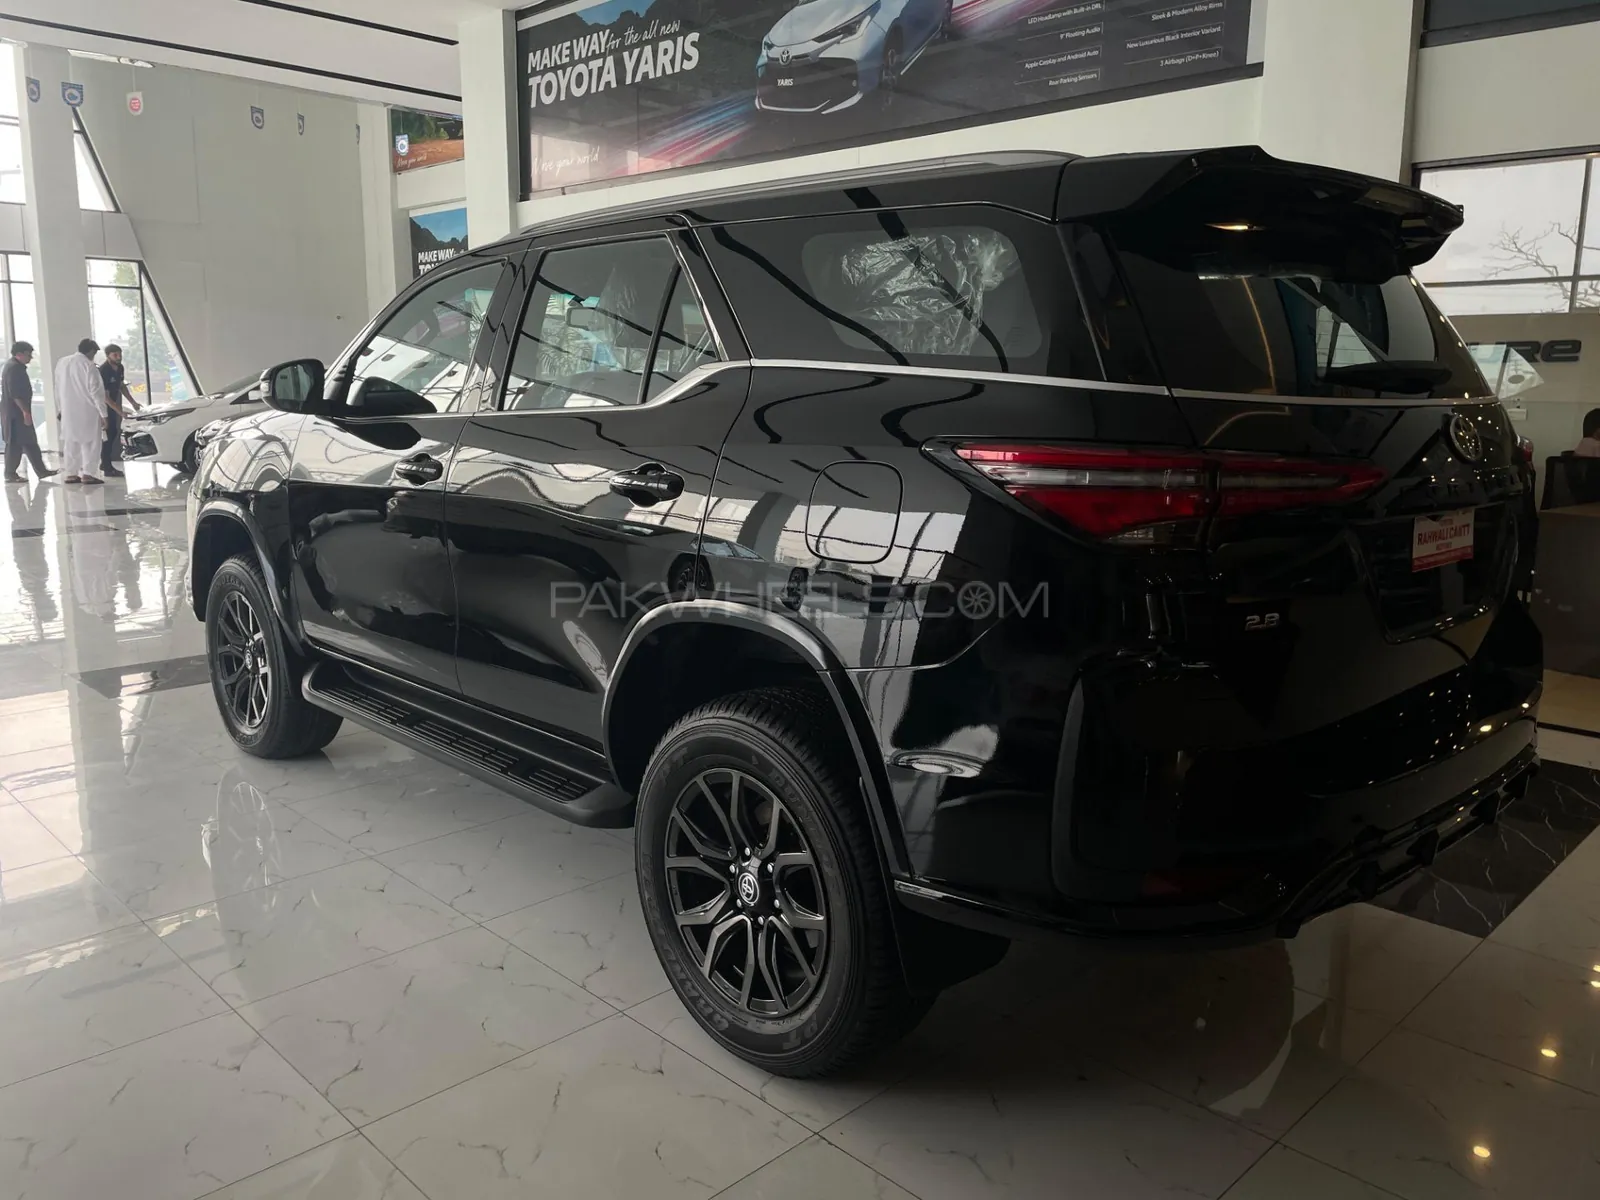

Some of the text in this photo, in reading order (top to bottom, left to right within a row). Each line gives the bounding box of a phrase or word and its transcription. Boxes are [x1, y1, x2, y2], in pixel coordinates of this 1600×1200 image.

[1201, 26, 1222, 35] Variant
[528, 19, 681, 74] MAKE WAY for the all new
[1066, 52, 1086, 60] Android
[528, 32, 700, 109] TOYOTA YARIS
[776, 78, 794, 86] YARIS
[1060, 76, 1078, 84] Parking
[418, 250, 438, 264] MAKE
[438, 248, 455, 261] WAY
